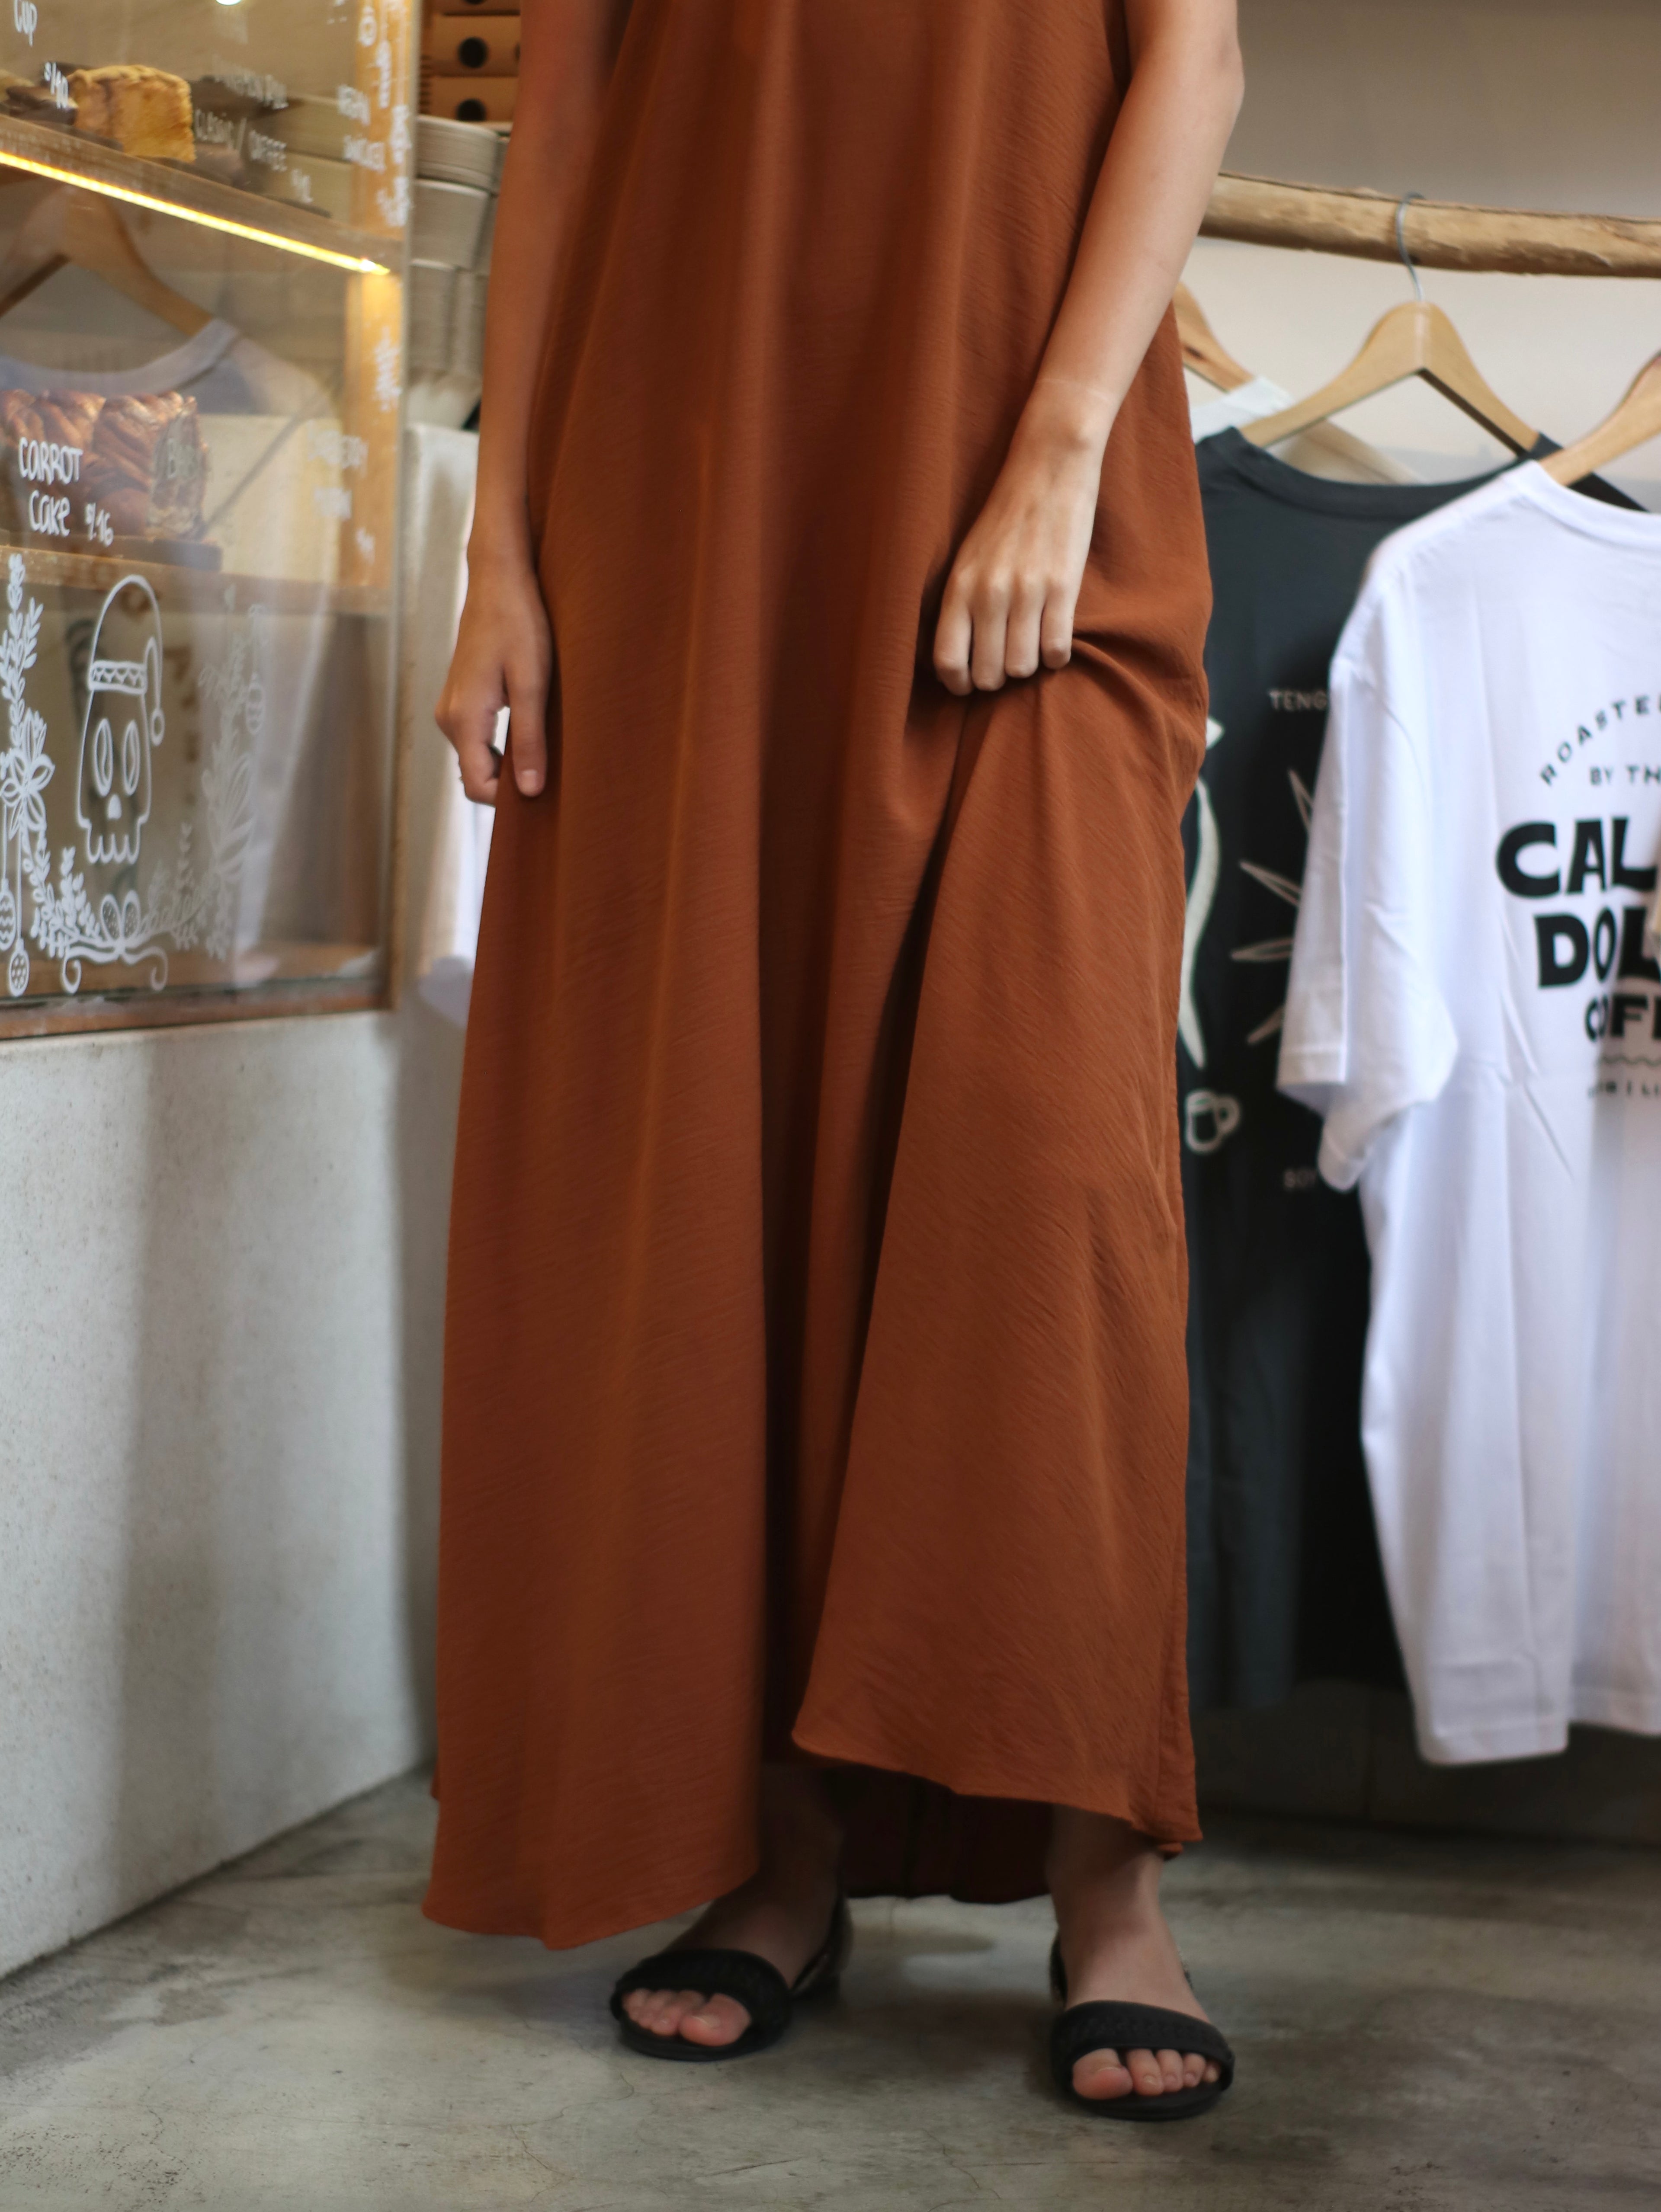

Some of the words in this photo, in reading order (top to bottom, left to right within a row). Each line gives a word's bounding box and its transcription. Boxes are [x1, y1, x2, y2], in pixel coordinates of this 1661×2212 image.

[1540, 693, 1661, 786] ROASTE
[1590, 766, 1613, 786] BY
[1495, 816, 1658, 899] CAL
